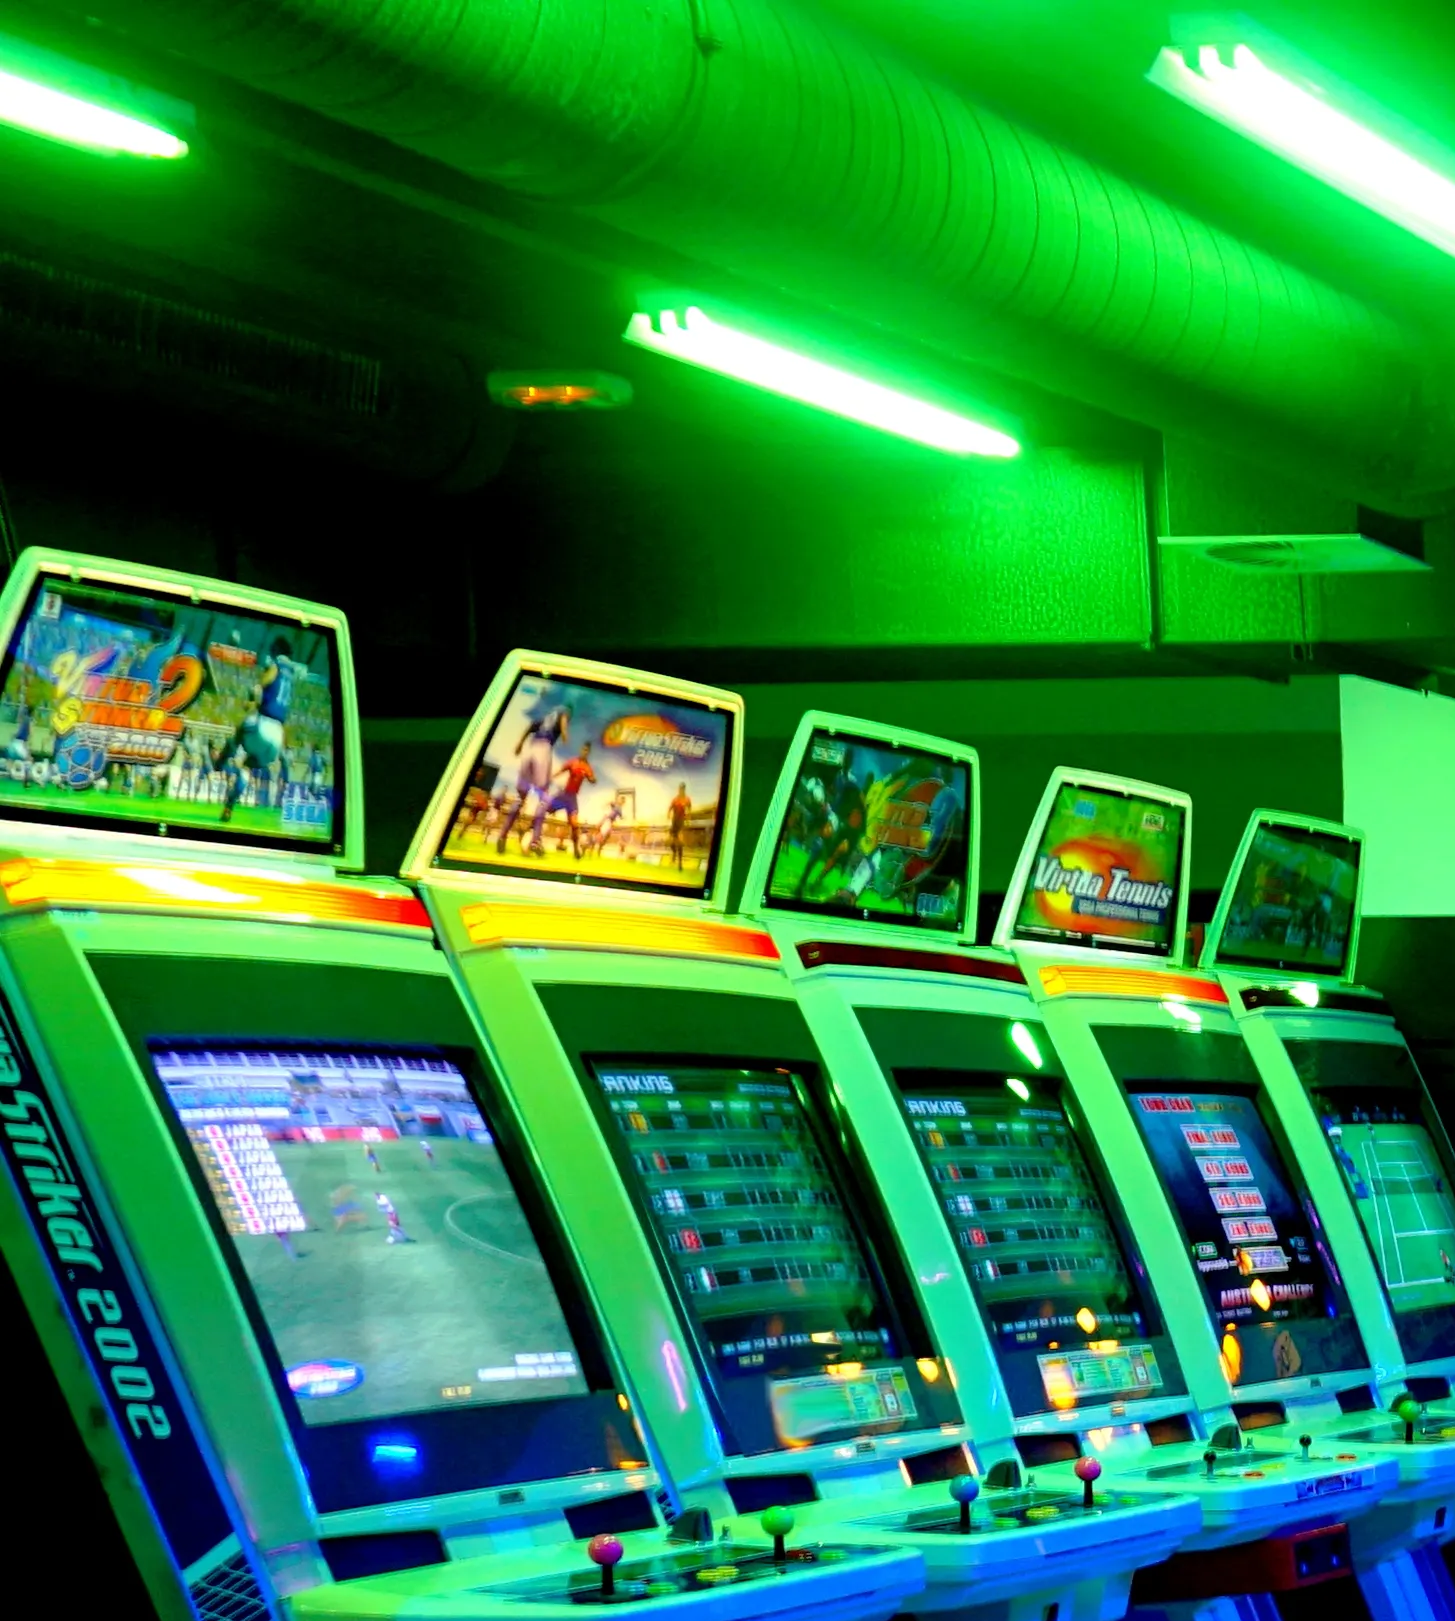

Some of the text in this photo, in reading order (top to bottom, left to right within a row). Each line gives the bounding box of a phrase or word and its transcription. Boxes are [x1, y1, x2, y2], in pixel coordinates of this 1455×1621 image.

[1034, 856, 1173, 908] Virtua Tennis
[602, 1075, 675, 1094] ANKING
[905, 1100, 967, 1116] ANKING
[78, 1288, 172, 1440] 2002
